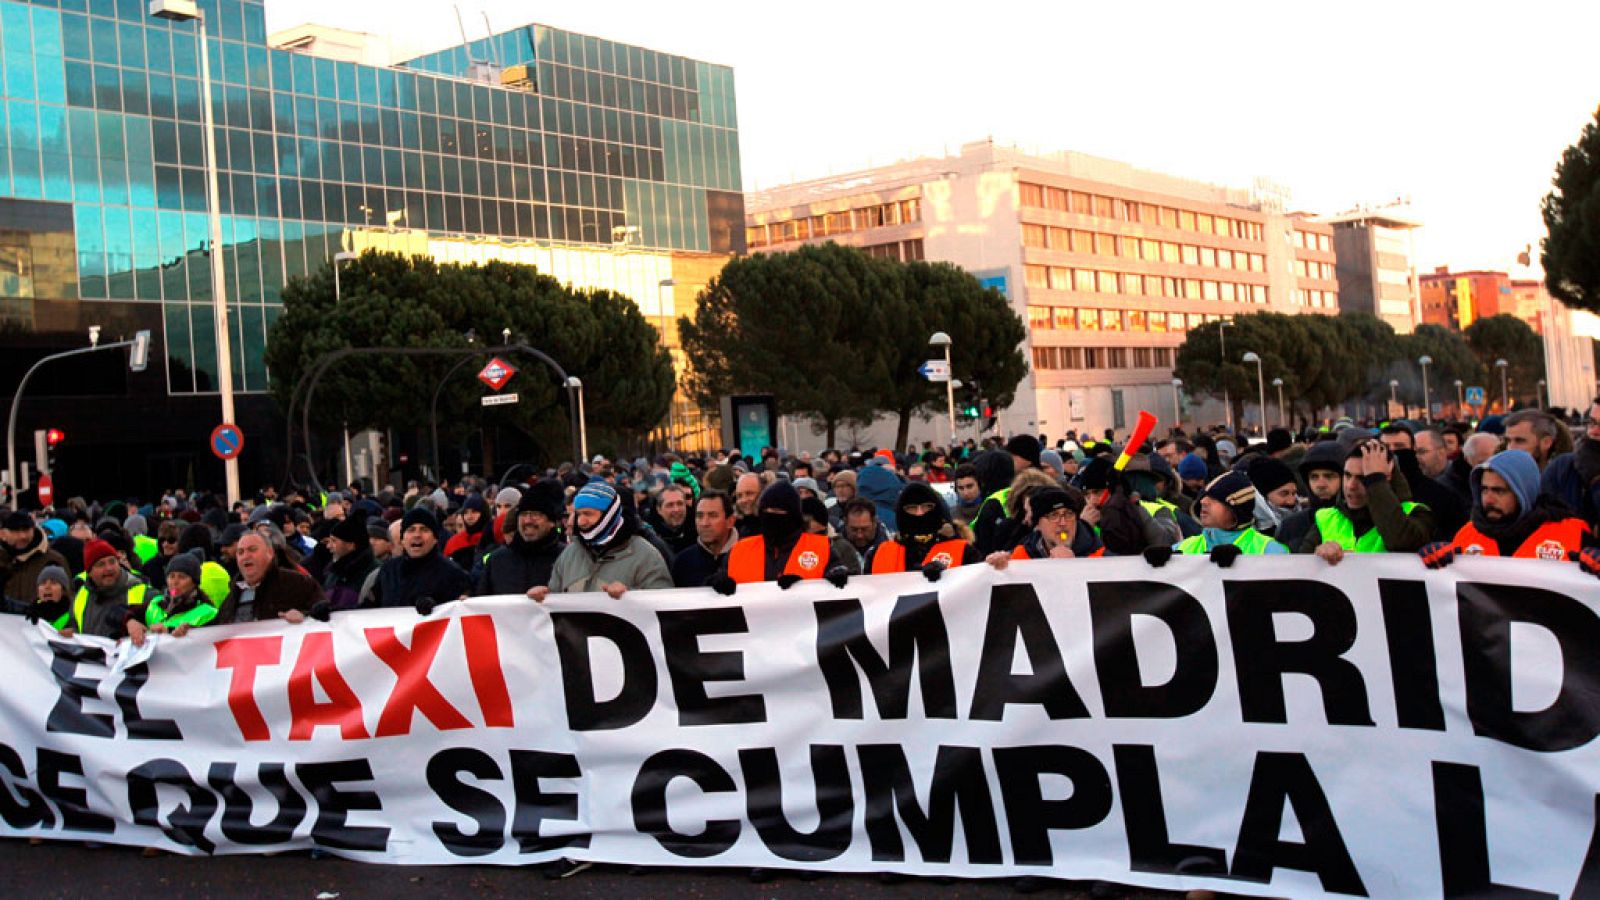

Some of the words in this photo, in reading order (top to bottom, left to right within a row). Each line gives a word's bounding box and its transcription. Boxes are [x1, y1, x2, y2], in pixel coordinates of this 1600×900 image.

[47, 641, 183, 740] EL
[214, 615, 514, 741] TAXI
[551, 607, 766, 731] DE
[814, 578, 1600, 753] MADRID
[126, 758, 390, 856] QUE
[426, 748, 591, 857] SE
[631, 744, 1370, 898] CUMPLA
